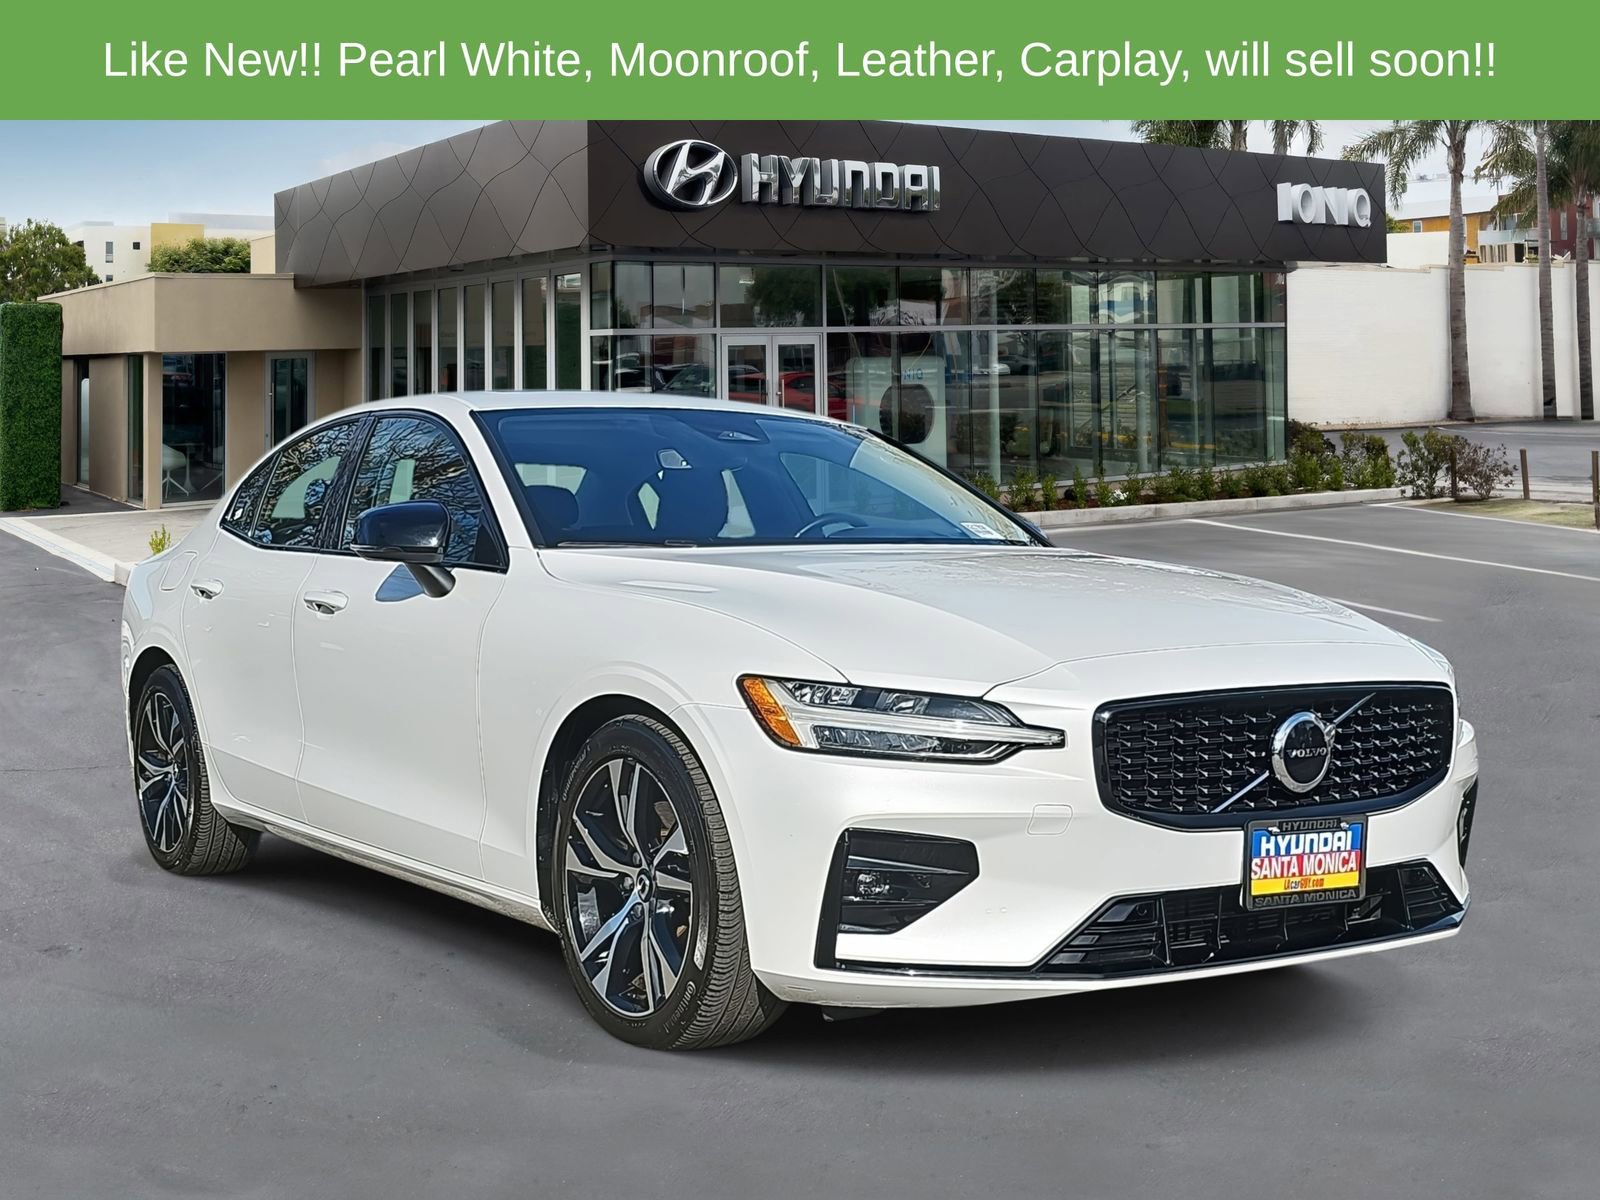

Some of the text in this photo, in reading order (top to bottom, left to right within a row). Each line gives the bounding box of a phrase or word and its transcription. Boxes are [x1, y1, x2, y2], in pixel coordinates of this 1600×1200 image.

[741, 153, 940, 212] HYUNDAI
[1277, 182, 1372, 228] IONIQ
[1287, 747, 1327, 758] VOLVO
[1282, 819, 1338, 832] HYUNDAI
[1260, 830, 1353, 857] HYUNDAI
[1251, 851, 1357, 879] SANTA MONICA
[1254, 889, 1357, 907] SANTA MONICA
